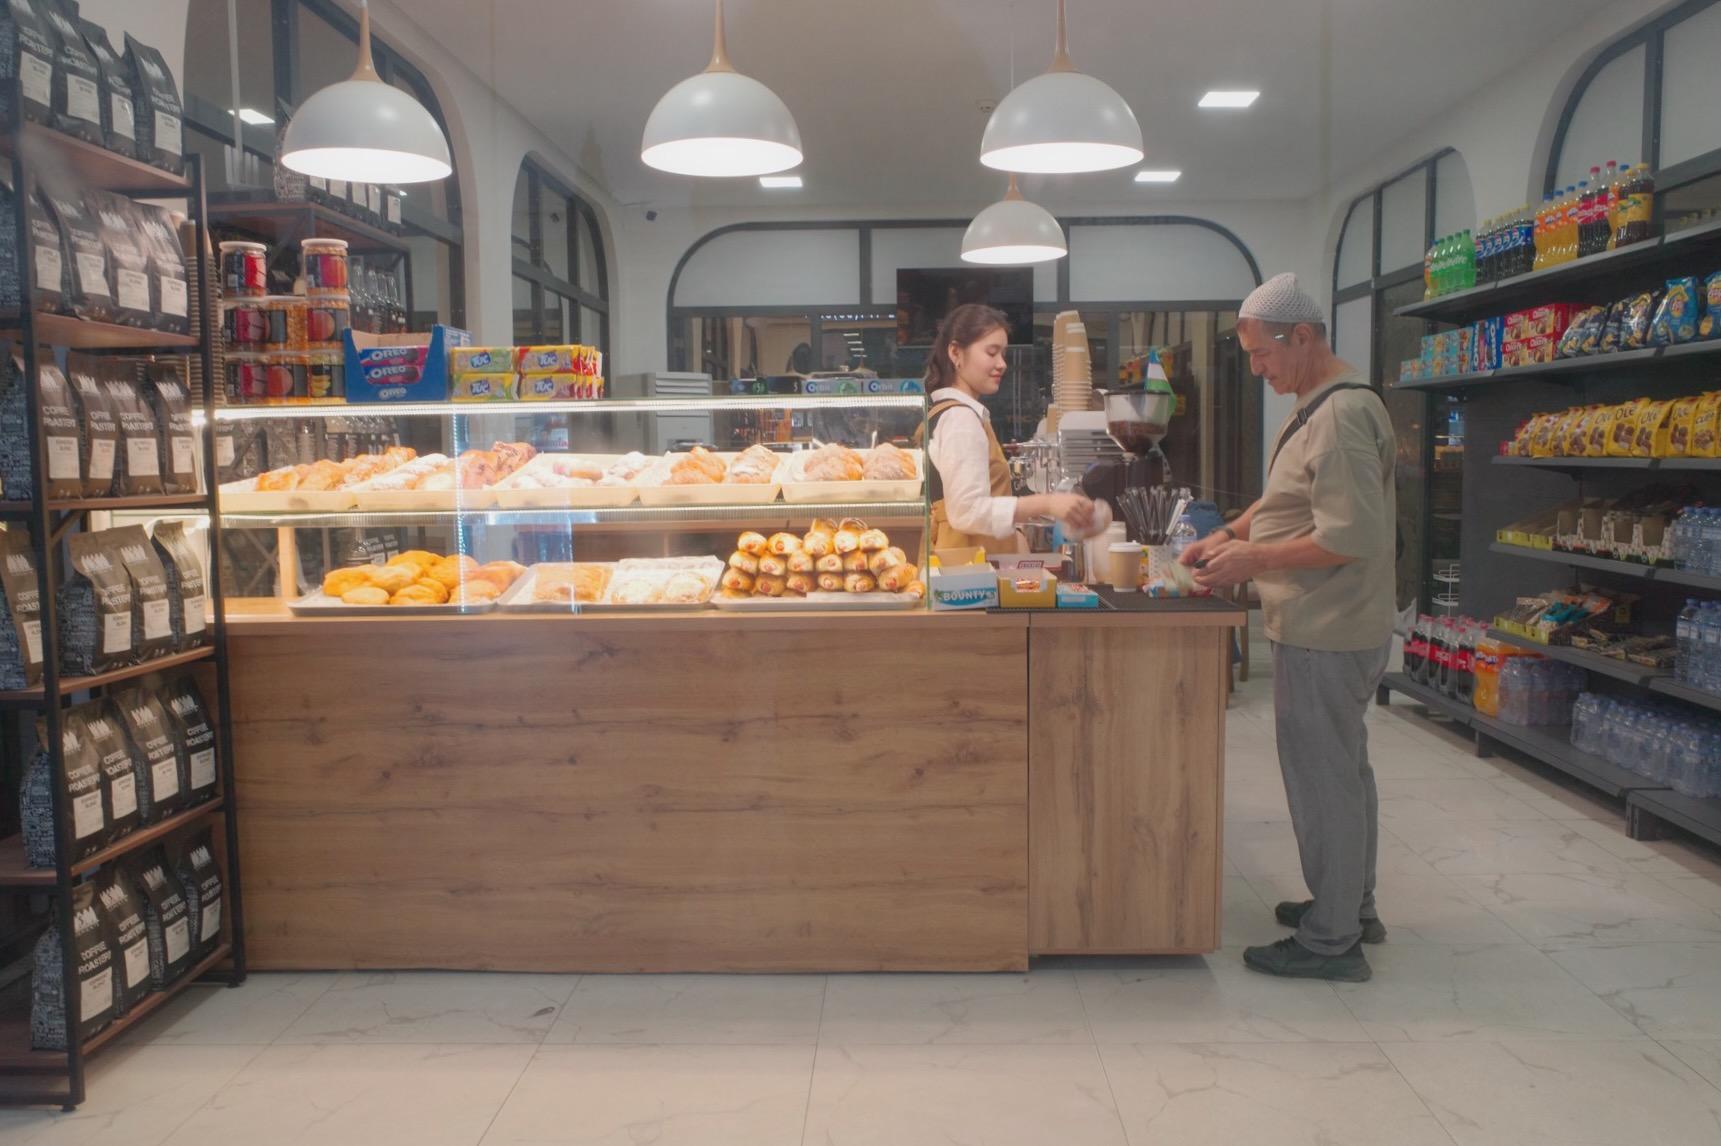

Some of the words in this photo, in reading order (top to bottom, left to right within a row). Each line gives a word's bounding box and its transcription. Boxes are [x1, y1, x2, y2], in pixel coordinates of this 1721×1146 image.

[371, 349, 408, 360] OREO
[370, 366, 406, 379] OREO
[943, 590, 985, 601] BOUNTY
